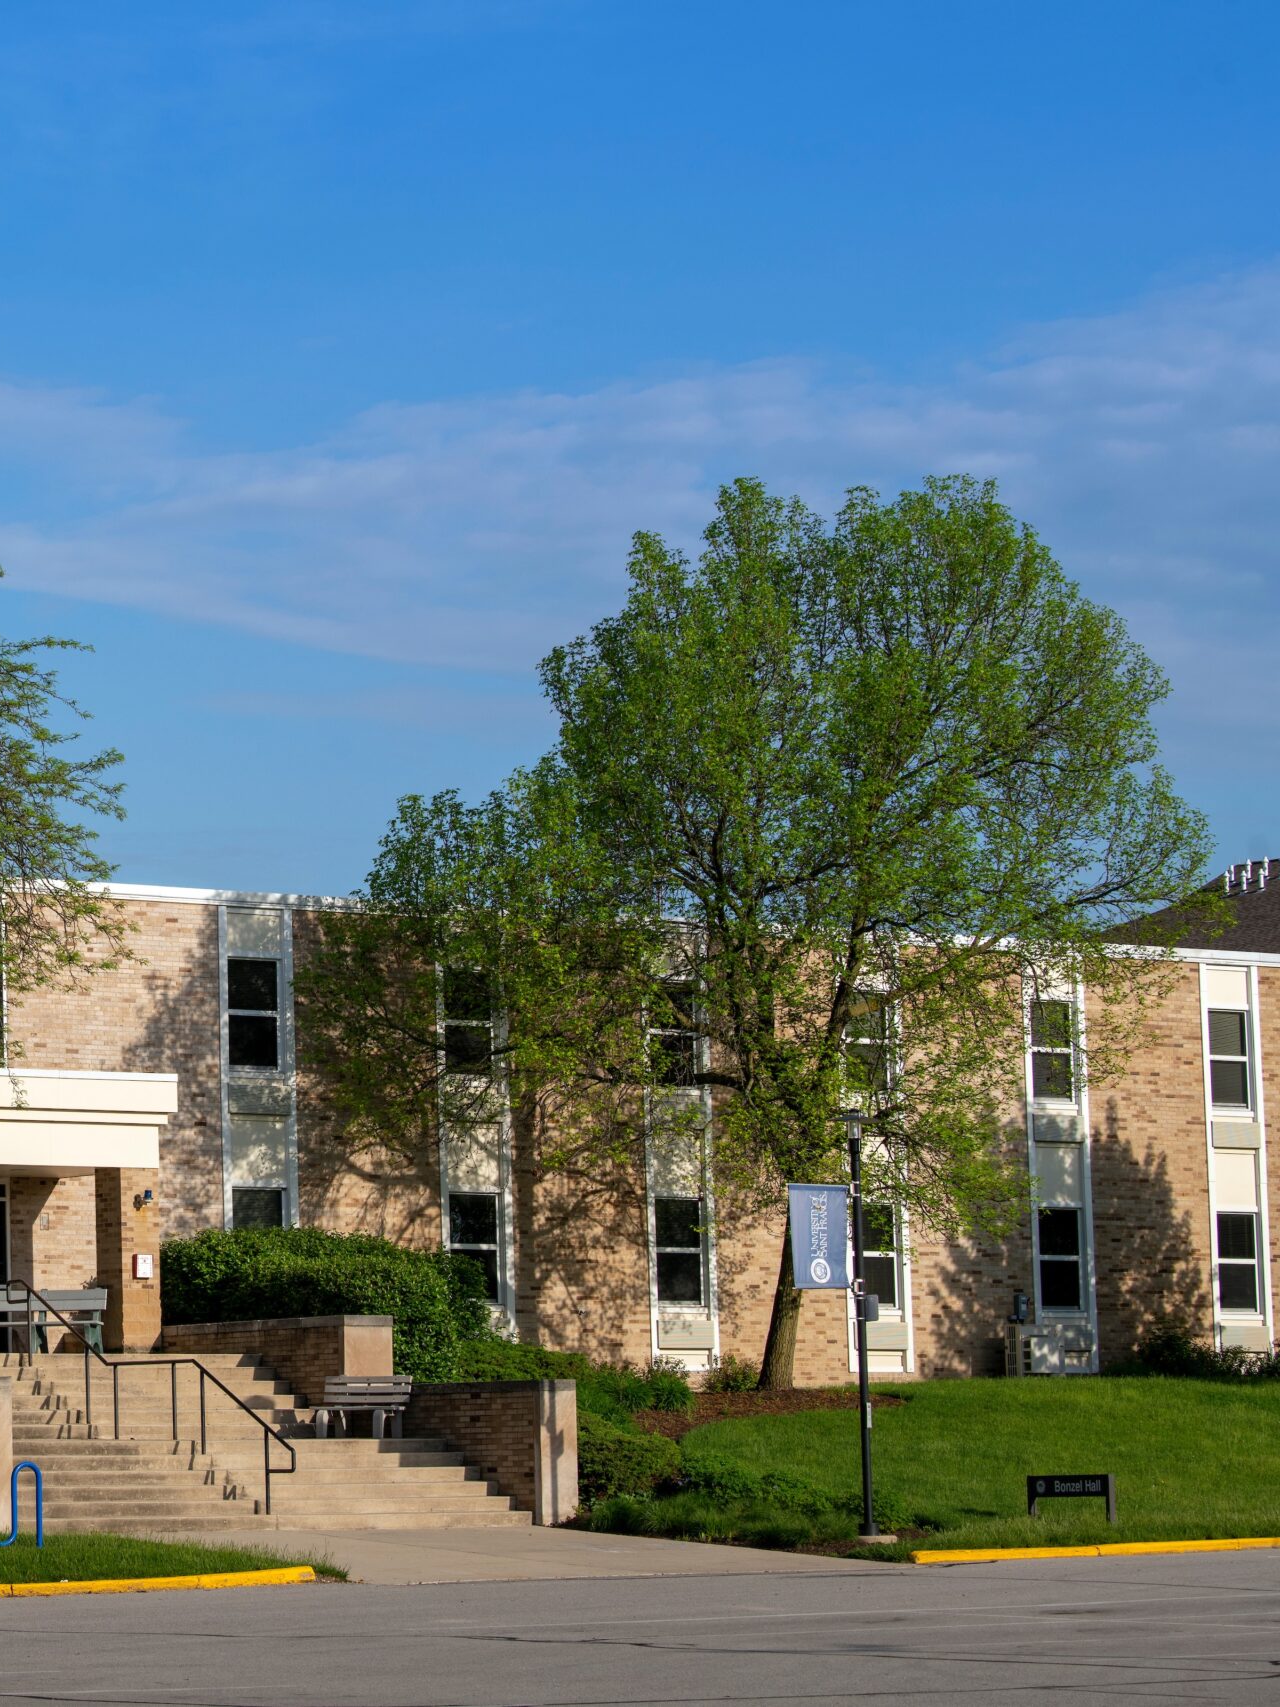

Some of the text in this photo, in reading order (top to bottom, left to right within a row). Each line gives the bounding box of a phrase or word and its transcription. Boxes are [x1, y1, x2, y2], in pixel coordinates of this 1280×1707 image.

[818, 1232, 828, 1257] SAINT
[1054, 1479, 1101, 1492] Bonzel Hall
